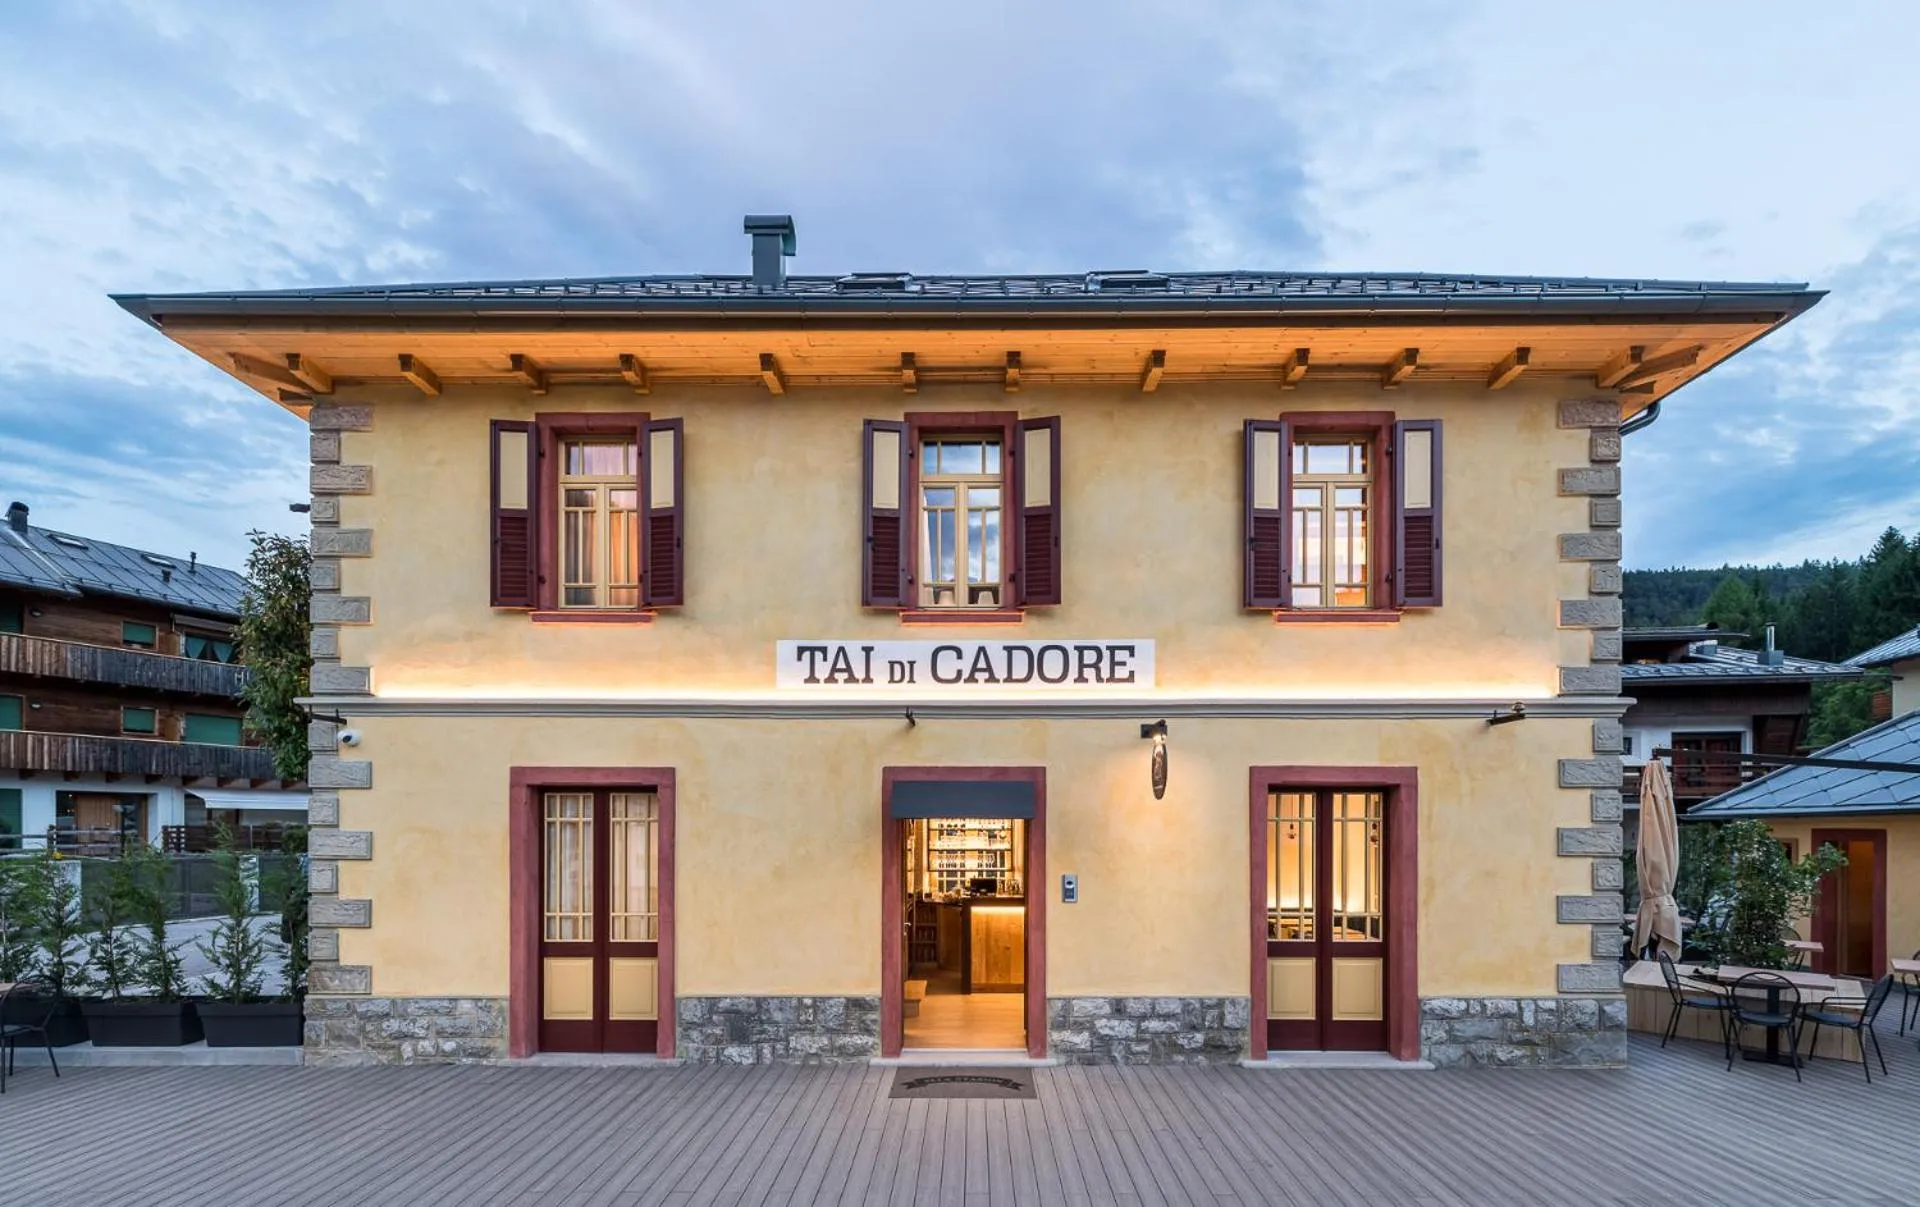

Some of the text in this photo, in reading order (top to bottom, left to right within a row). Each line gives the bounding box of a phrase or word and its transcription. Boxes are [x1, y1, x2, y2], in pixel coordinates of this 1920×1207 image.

[797, 645, 1135, 684] TAI DI CADORE
